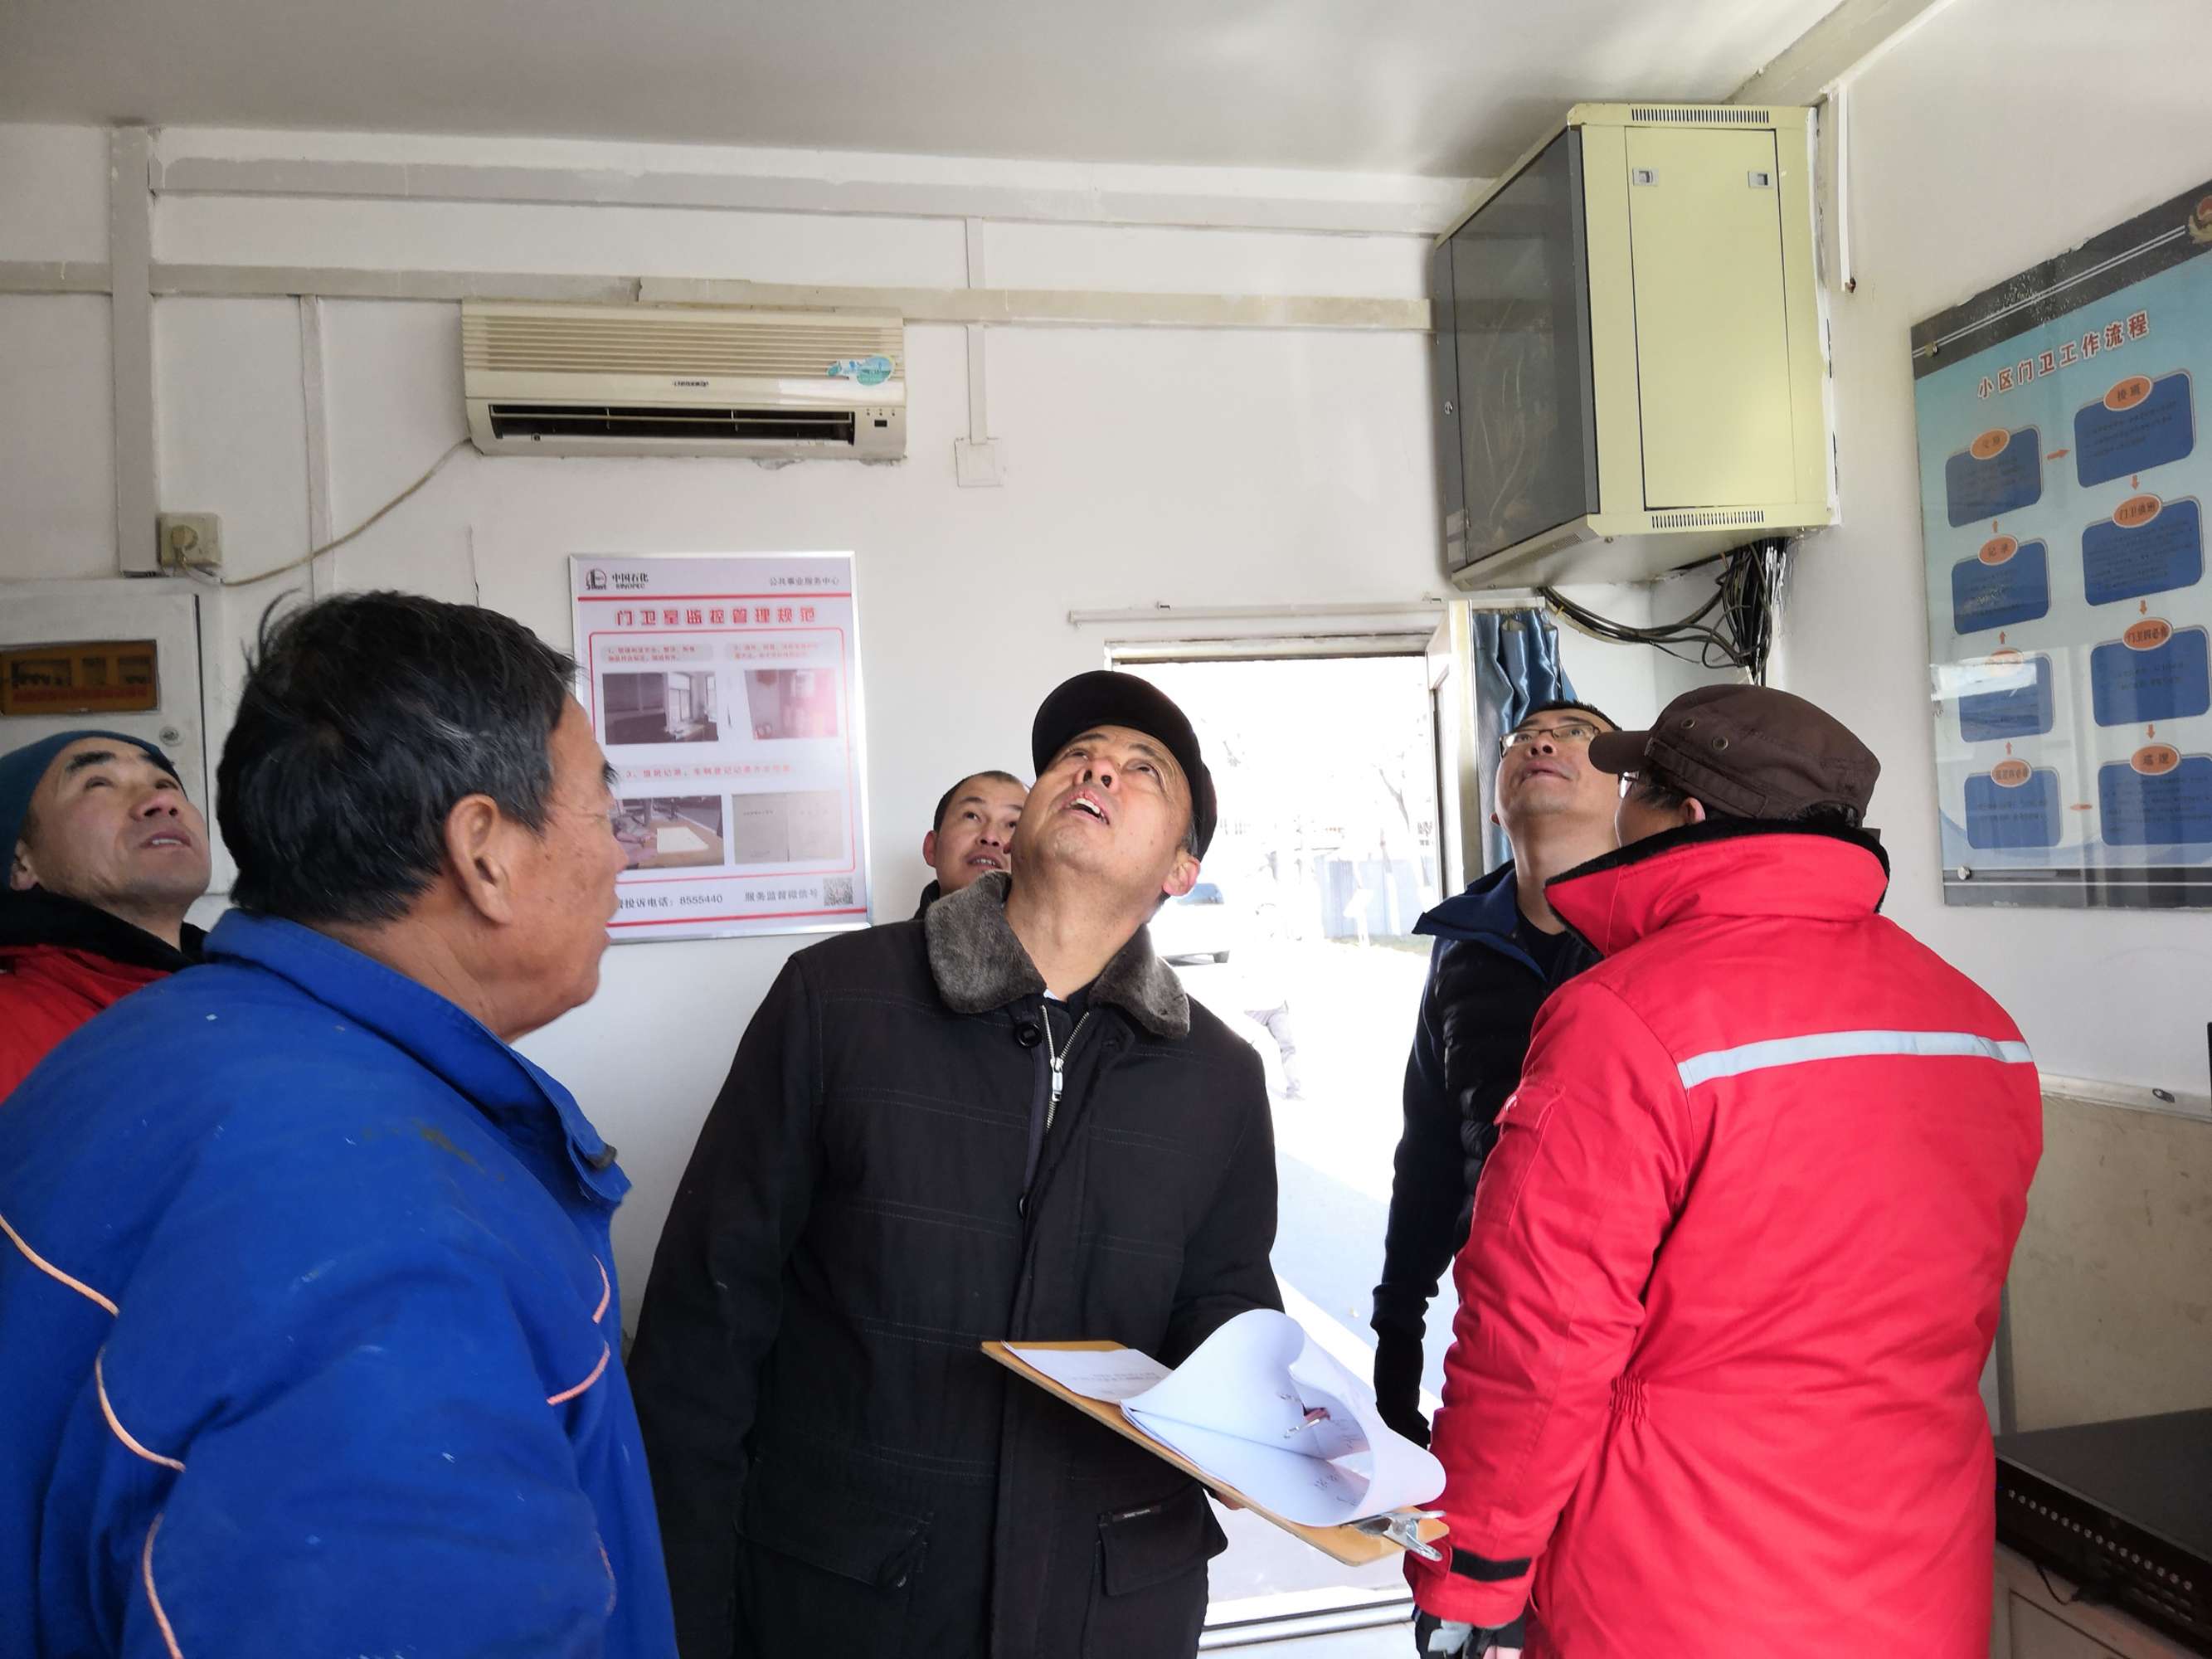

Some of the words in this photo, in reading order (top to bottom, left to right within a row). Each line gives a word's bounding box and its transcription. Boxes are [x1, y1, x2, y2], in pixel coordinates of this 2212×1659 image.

[1977, 312, 2149, 398] 小区门卫工作流程
[612, 572, 649, 582] 中国石化
[616, 606, 816, 625] 门卫室监控管理规范
